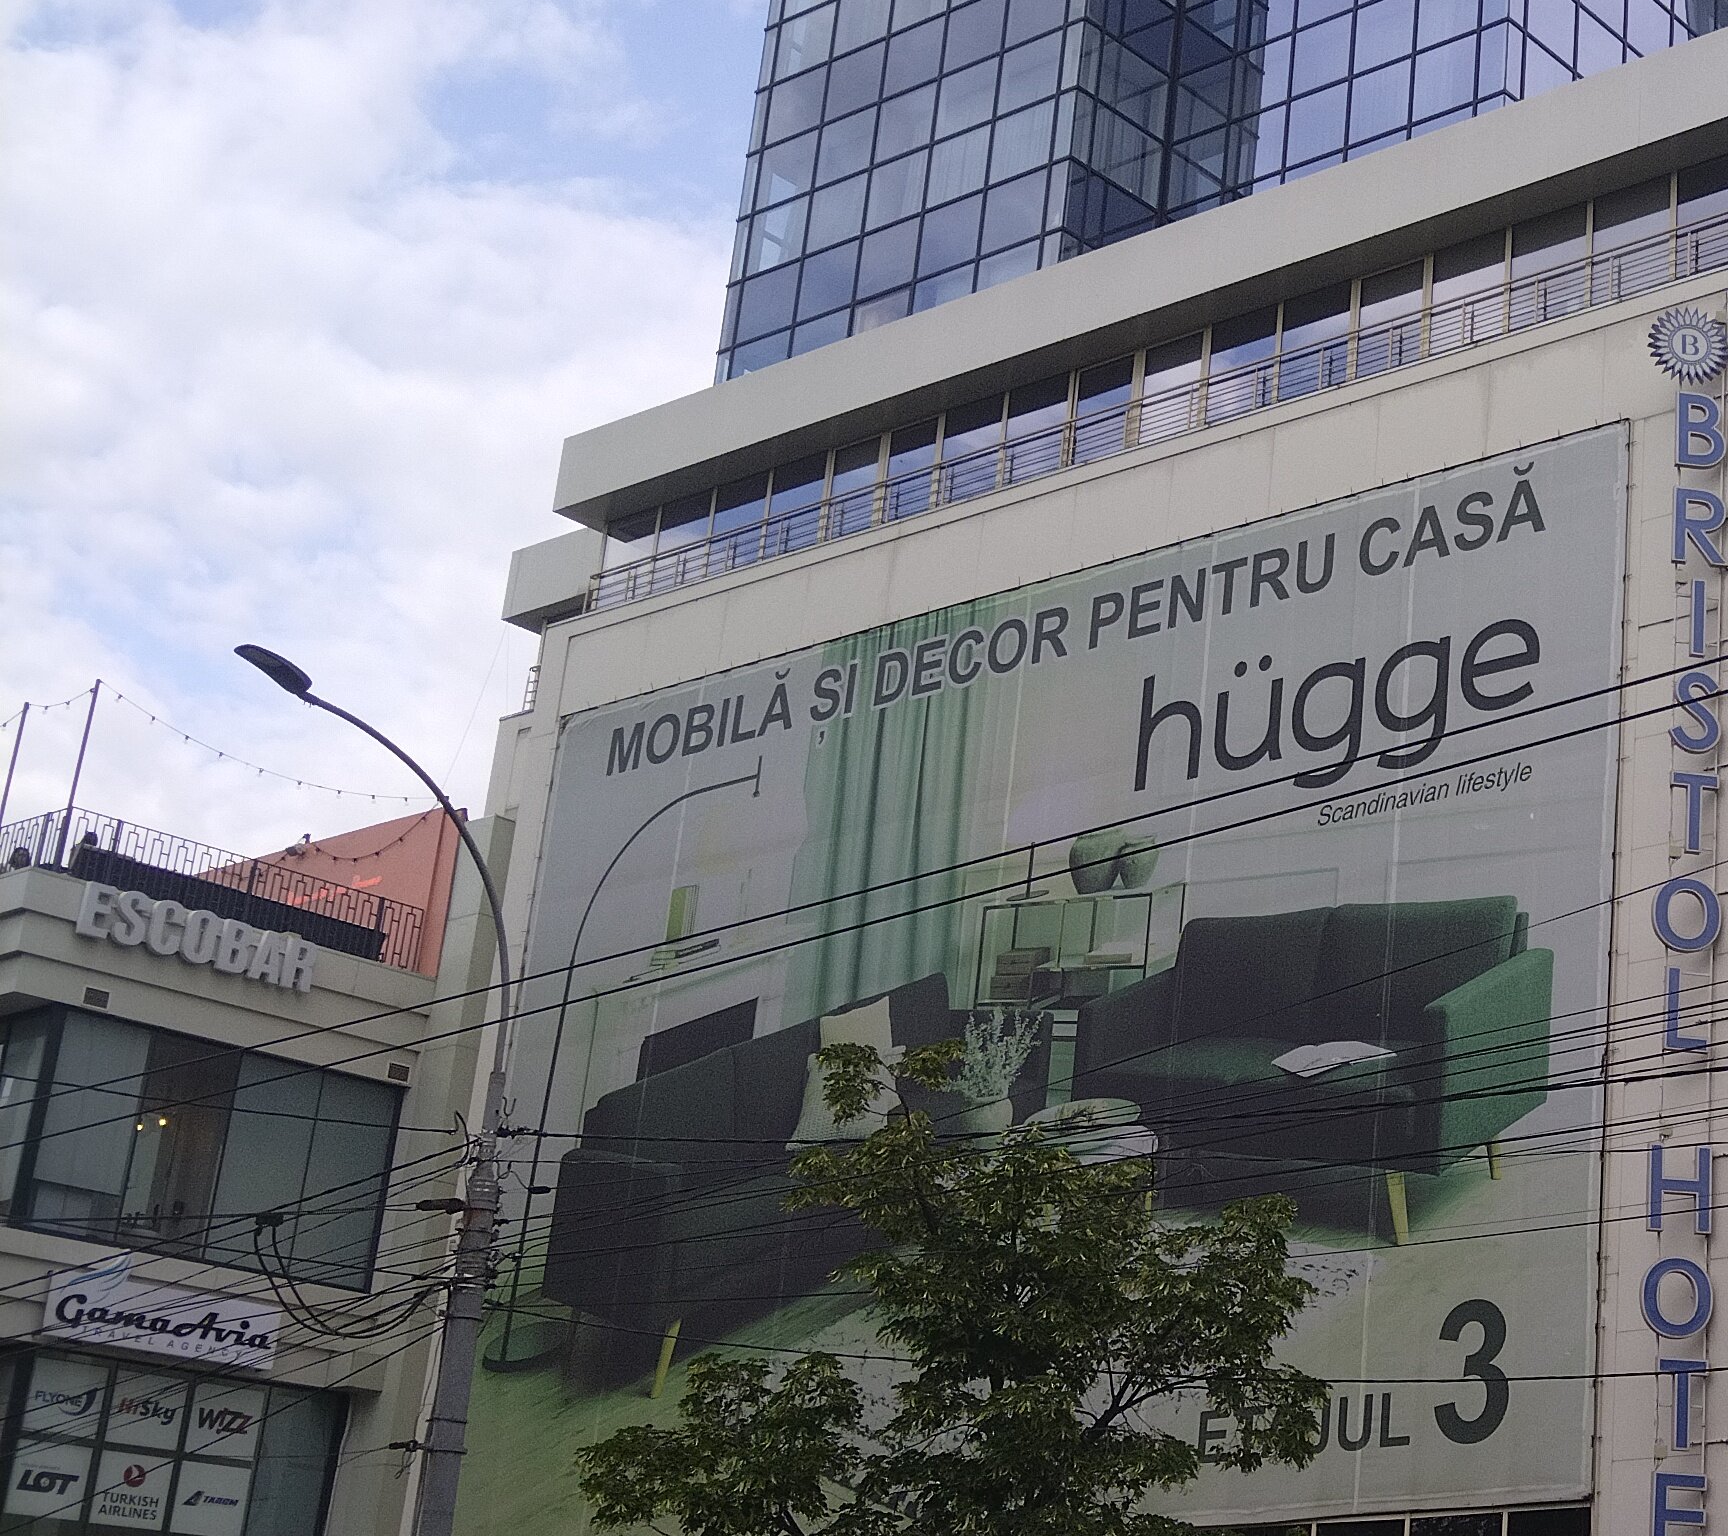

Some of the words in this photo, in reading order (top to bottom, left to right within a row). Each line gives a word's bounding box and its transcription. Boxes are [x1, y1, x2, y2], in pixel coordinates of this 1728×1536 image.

[1681, 333, 1700, 356] B
[606, 668, 793, 777] MOBILĂ
[809, 664, 858, 745] ȘI
[873, 606, 1069, 707] DECOR
[1088, 533, 1336, 650] PENTRU
[1358, 461, 1545, 577] CASĂ
[1134, 618, 1541, 792] hügge
[1651, 391, 1728, 1053] BRISTOL
[1317, 779, 1450, 827] Scandinavian
[1455, 762, 1533, 797] lifestyle
[76, 880, 318, 993] ESCOBAR
[82, 1326, 155, 1346] TRAVEL
[1434, 1299, 1509, 1444] 3
[16, 1469, 80, 1495] LOT
[98, 1504, 158, 1521] AIRLINES
[102, 1492, 159, 1508] TURKISH
